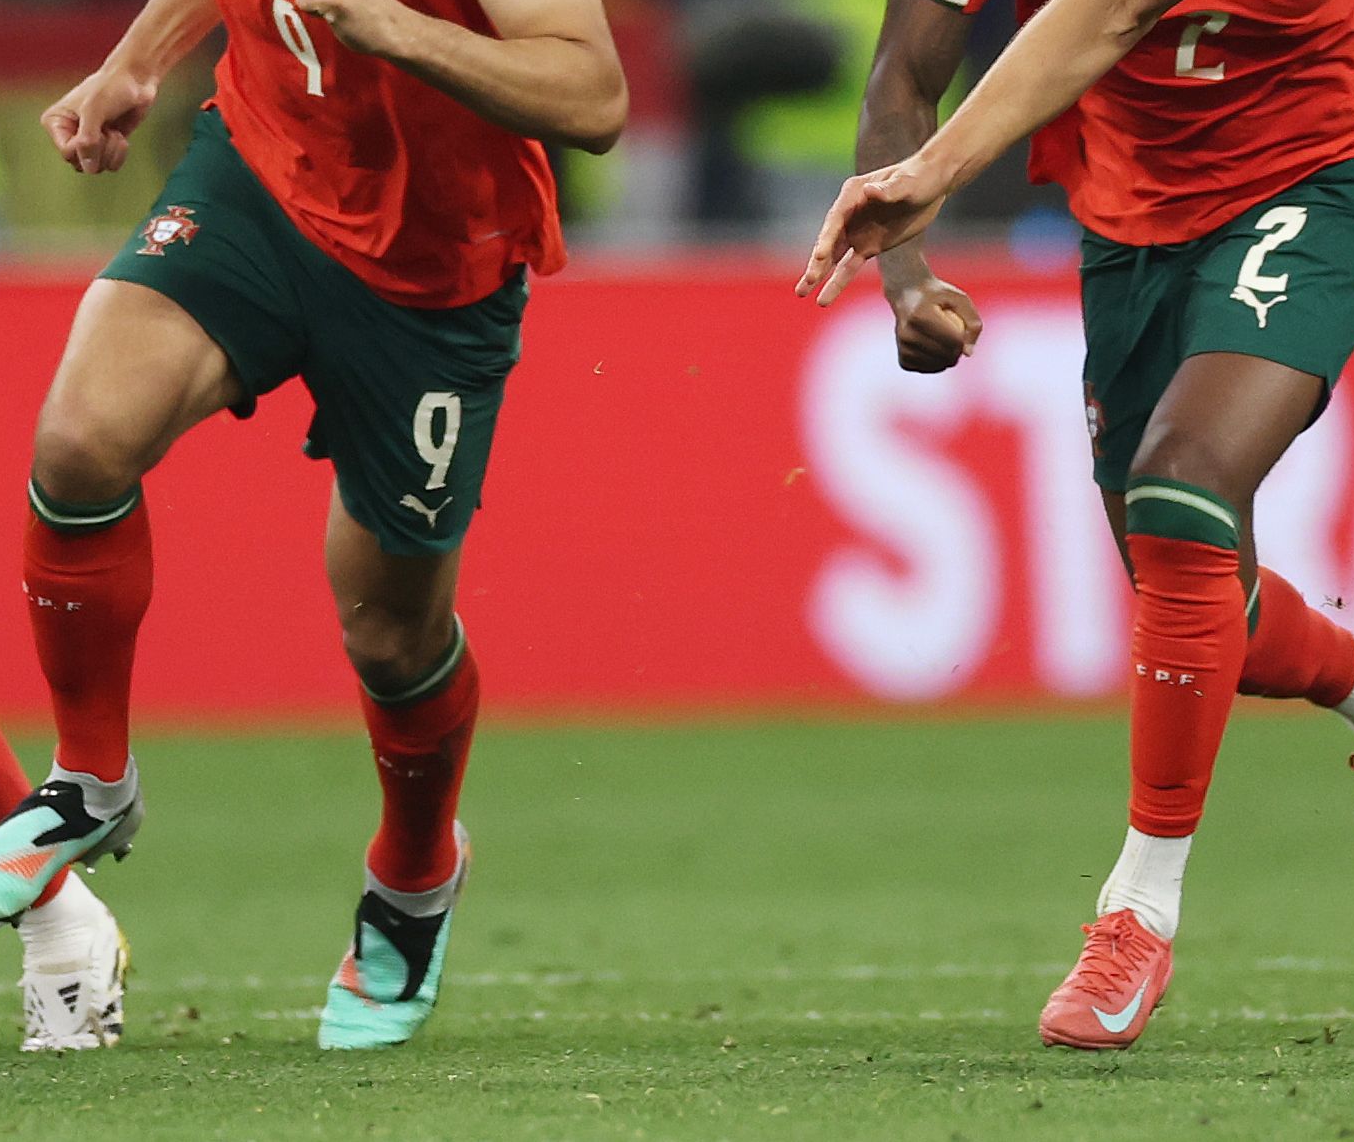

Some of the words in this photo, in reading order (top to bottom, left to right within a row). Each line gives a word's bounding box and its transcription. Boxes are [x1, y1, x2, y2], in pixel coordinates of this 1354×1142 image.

[1174, 10, 1230, 81] 2
[1237, 205, 1308, 292] 2
[413, 391, 462, 490] 9
